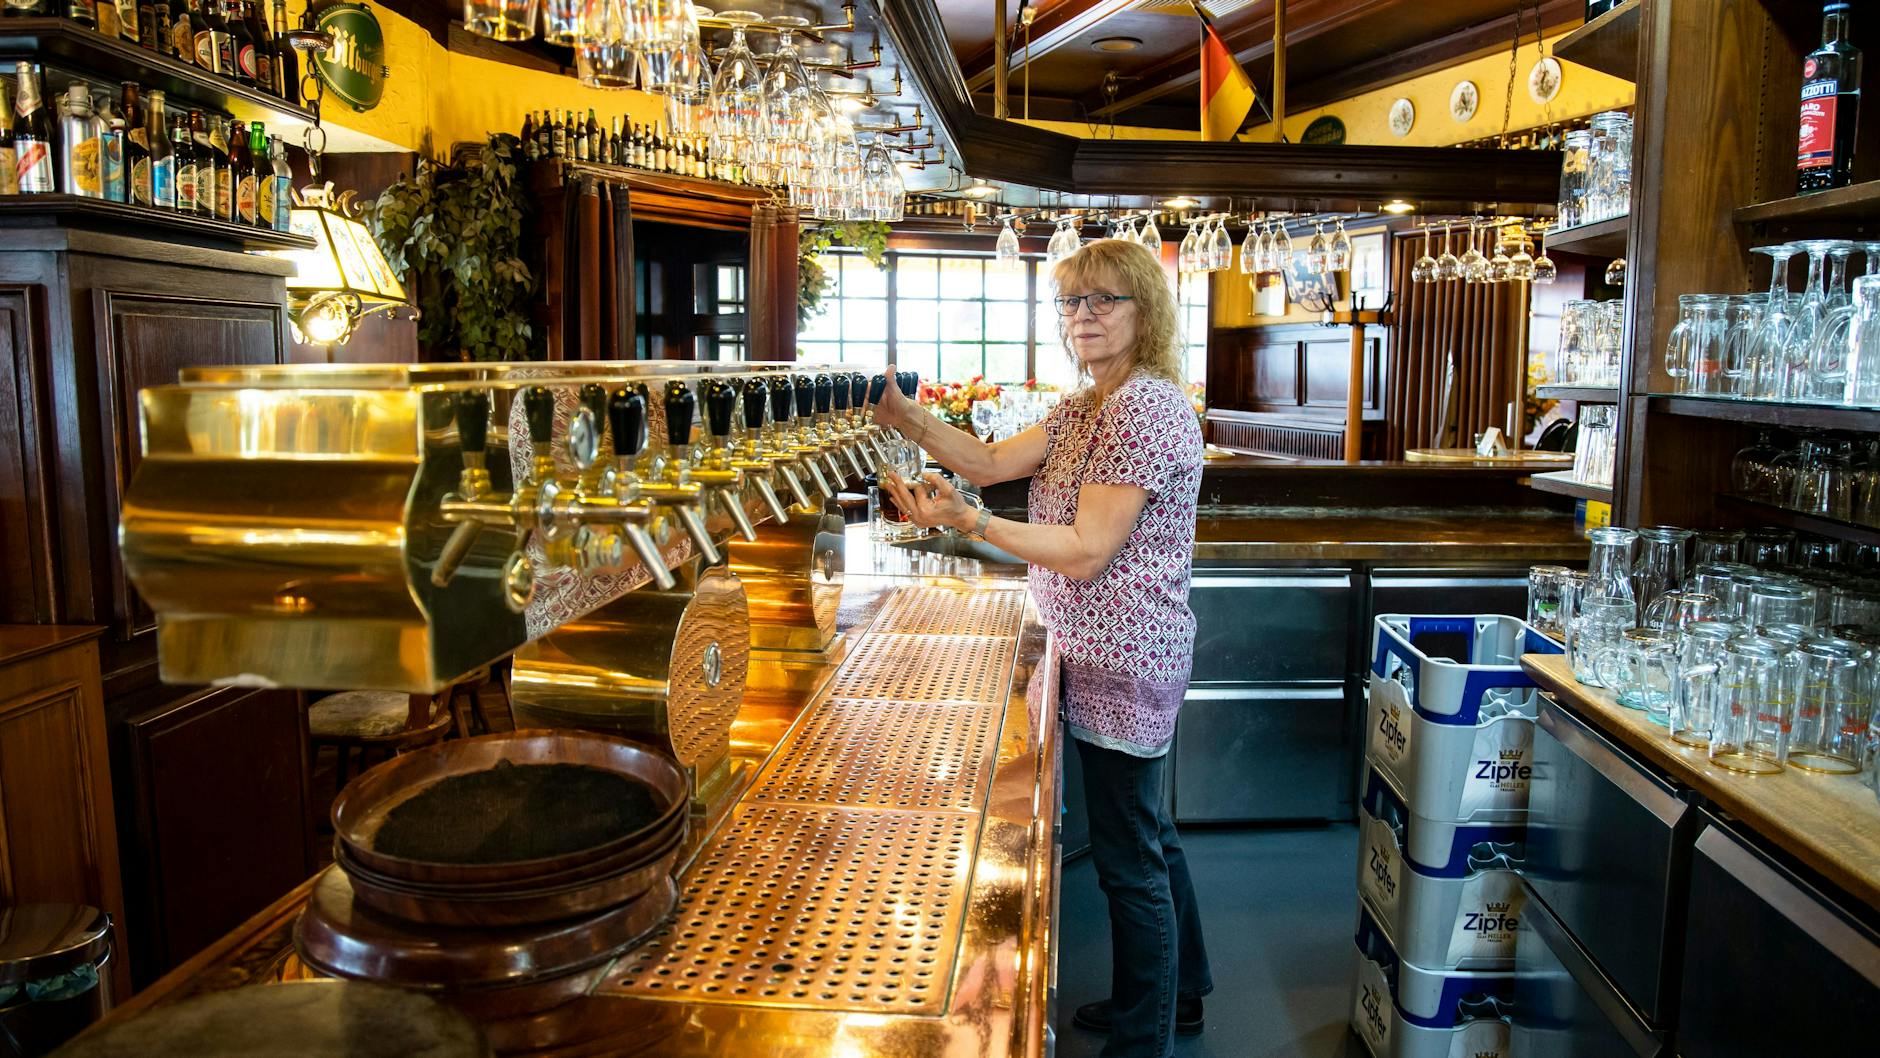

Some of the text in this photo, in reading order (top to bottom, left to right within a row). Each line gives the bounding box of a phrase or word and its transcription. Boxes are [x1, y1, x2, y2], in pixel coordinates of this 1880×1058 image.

[1380, 708, 1406, 754] Zipfer
[1475, 760, 1532, 783] Zipfe
[1370, 845, 1396, 898] Zipfer
[1463, 912, 1519, 934] Zipfe
[1361, 984, 1386, 1041] Zipfer
